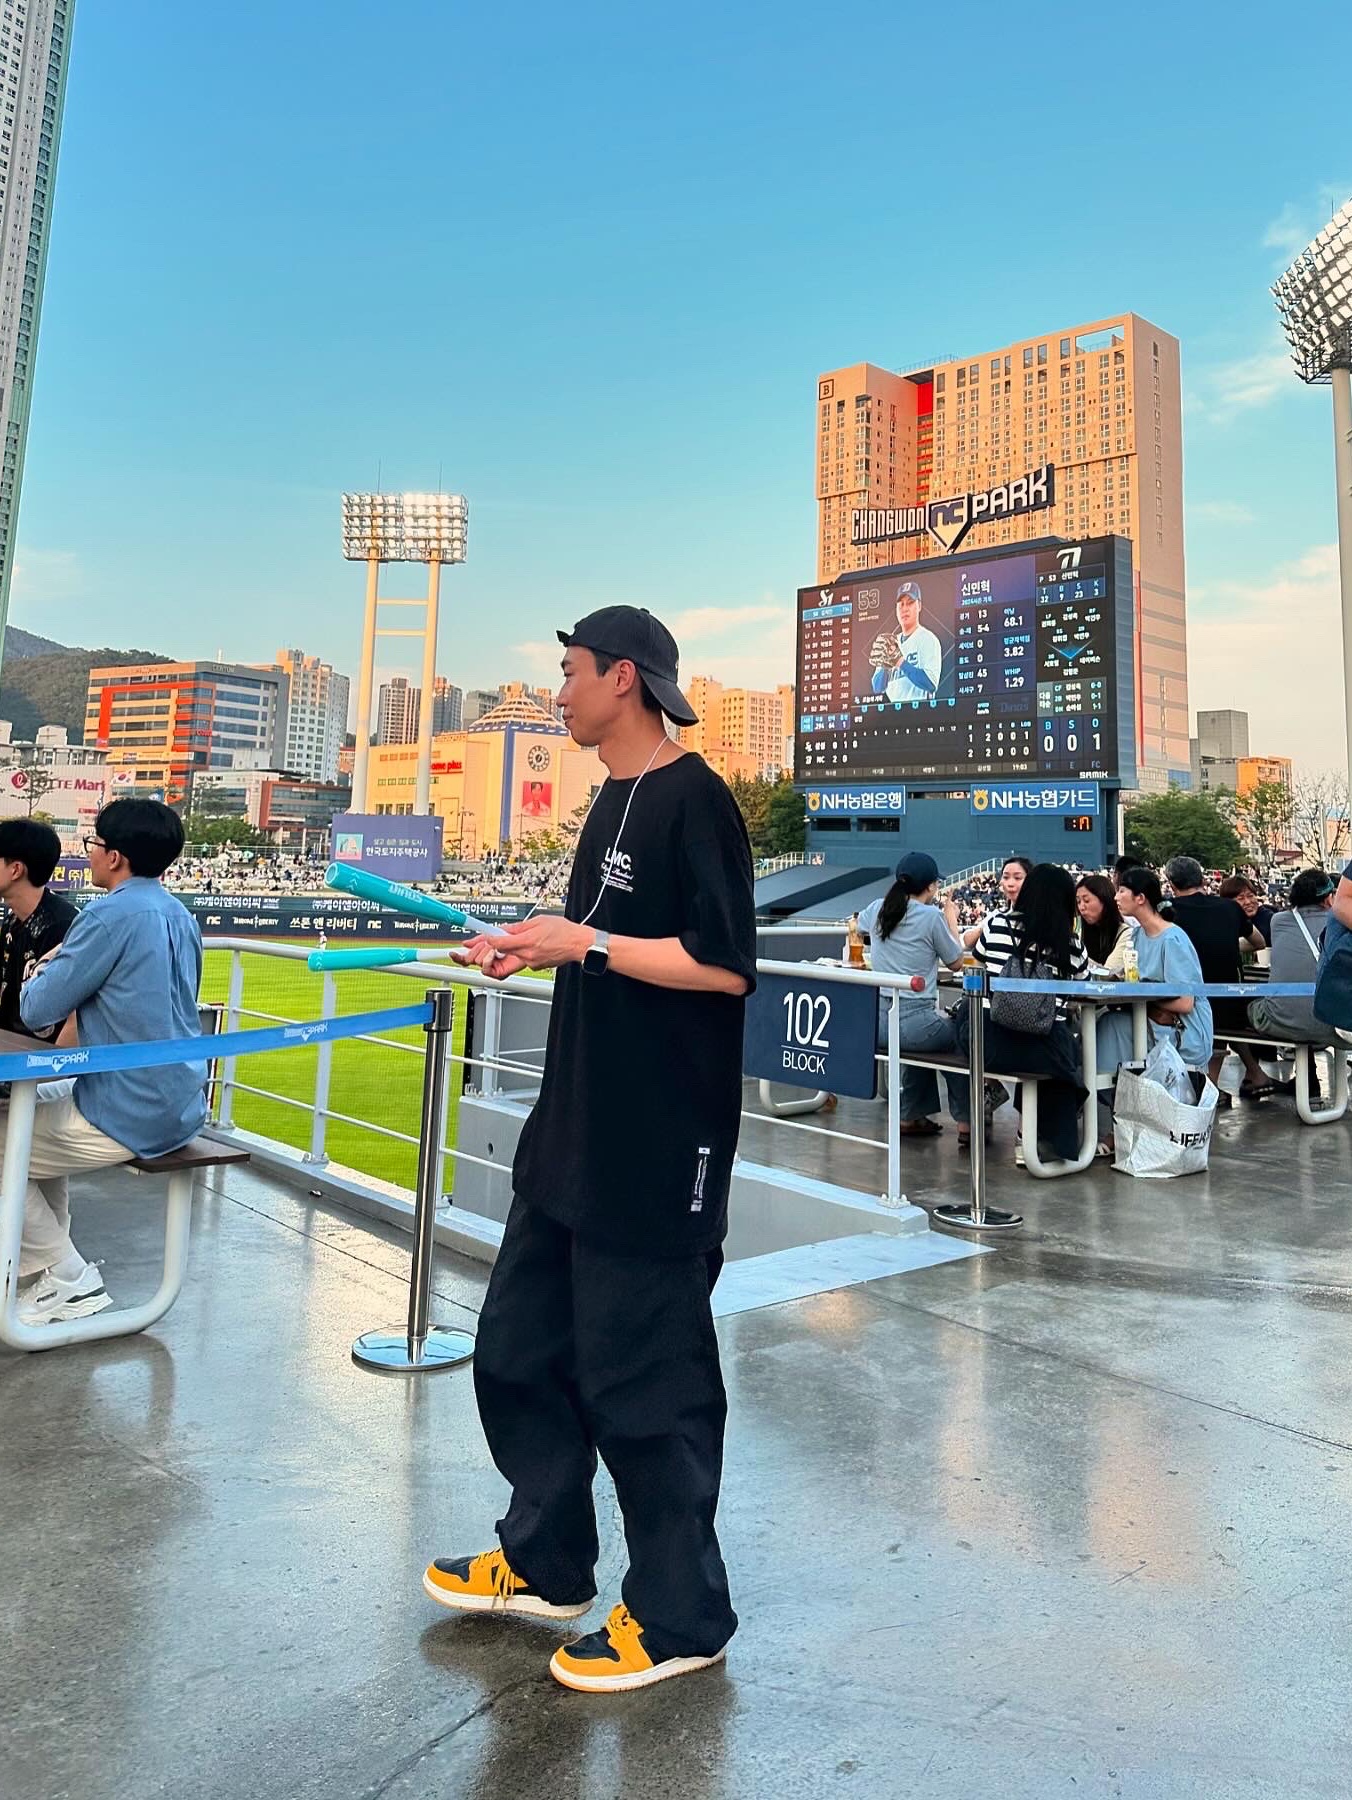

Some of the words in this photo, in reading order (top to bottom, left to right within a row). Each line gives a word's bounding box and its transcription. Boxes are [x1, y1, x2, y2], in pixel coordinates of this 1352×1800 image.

[851, 507, 925, 541] CHANGWON
[972, 468, 1048, 519] PARK
[1048, 574, 1057, 582] 53
[961, 579, 990, 596] 신민혁
[858, 588, 880, 611] 53
[1040, 595, 1049, 604] 32
[1074, 590, 1084, 599] 23
[978, 609, 988, 619] 13
[1003, 615, 1023, 627] 68.1
[977, 639, 983, 649] 0
[977, 653, 983, 663] 0
[1004, 646, 1024, 658] 3.82
[1004, 667, 1021, 676] WHIP
[977, 684, 983, 693] 7
[1004, 676, 1025, 689] 1.29
[1045, 721, 1052, 730] B
[1068, 719, 1075, 729] S
[985, 732, 991, 742] 2
[997, 731, 1004, 741] 0
[1010, 731, 1017, 741] 0
[1043, 735, 1054, 753] 0
[1067, 734, 1078, 752] 0
[1092, 733, 1101, 751] 1
[816, 756, 825, 764] NC
[967, 748, 974, 758] 2
[985, 747, 991, 757] 2
[997, 747, 1004, 757] 0
[1010, 746, 1017, 756] 0
[1023, 746, 1030, 756] 0
[447, 760, 462, 773] plus
[1091, 760, 1101, 769] FC
[74, 779, 105, 791] Mart
[822, 792, 902, 810] NH농협은행
[991, 789, 1095, 809] NH농협카드
[365, 846, 428, 858] 한국토지주택공사
[312, 917, 325, 930] 앤
[326, 917, 358, 931] 리버티
[783, 992, 831, 1048] 102
[64, 1050, 90, 1064] PARK
[782, 1050, 826, 1075] BLOCK
